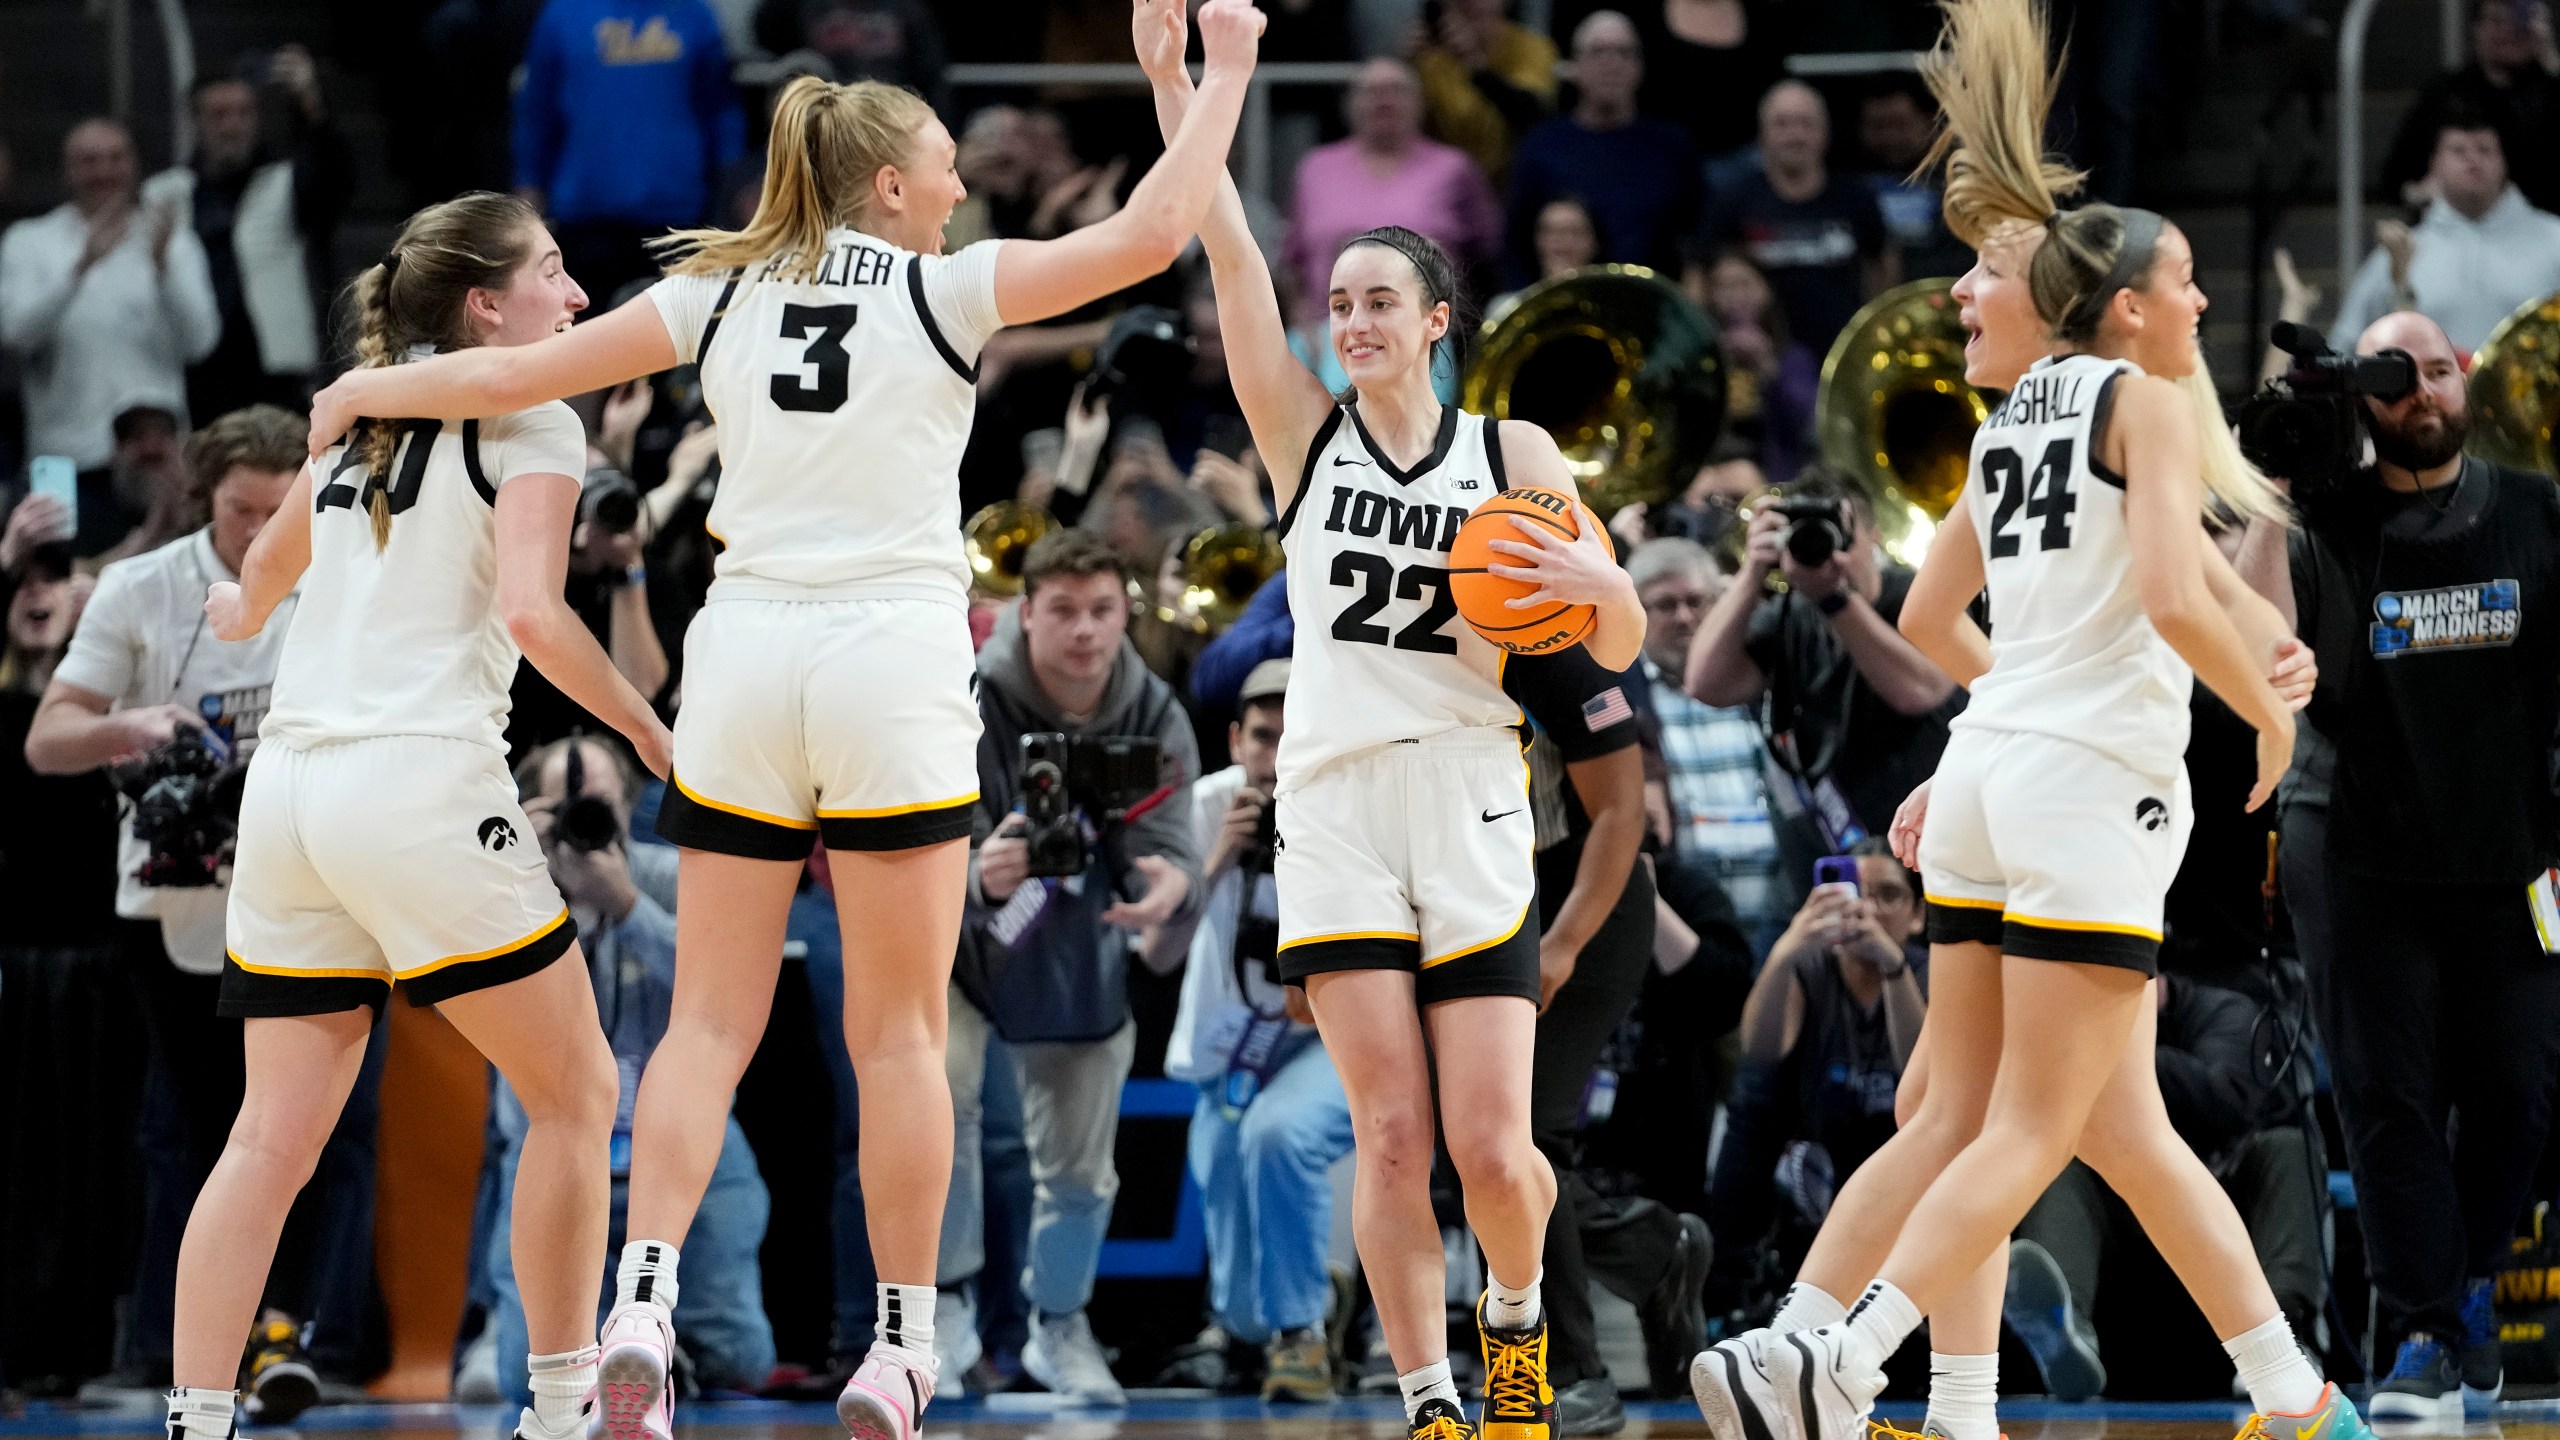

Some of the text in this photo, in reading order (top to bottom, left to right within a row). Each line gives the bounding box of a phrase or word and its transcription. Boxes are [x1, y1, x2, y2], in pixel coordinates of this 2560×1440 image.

[770, 302, 859, 413] 3
[1981, 437, 2078, 559] 24
[1329, 549, 1459, 657] 22
[2401, 588, 2480, 619] MARCH
[2413, 609, 2517, 642] MADNESS
